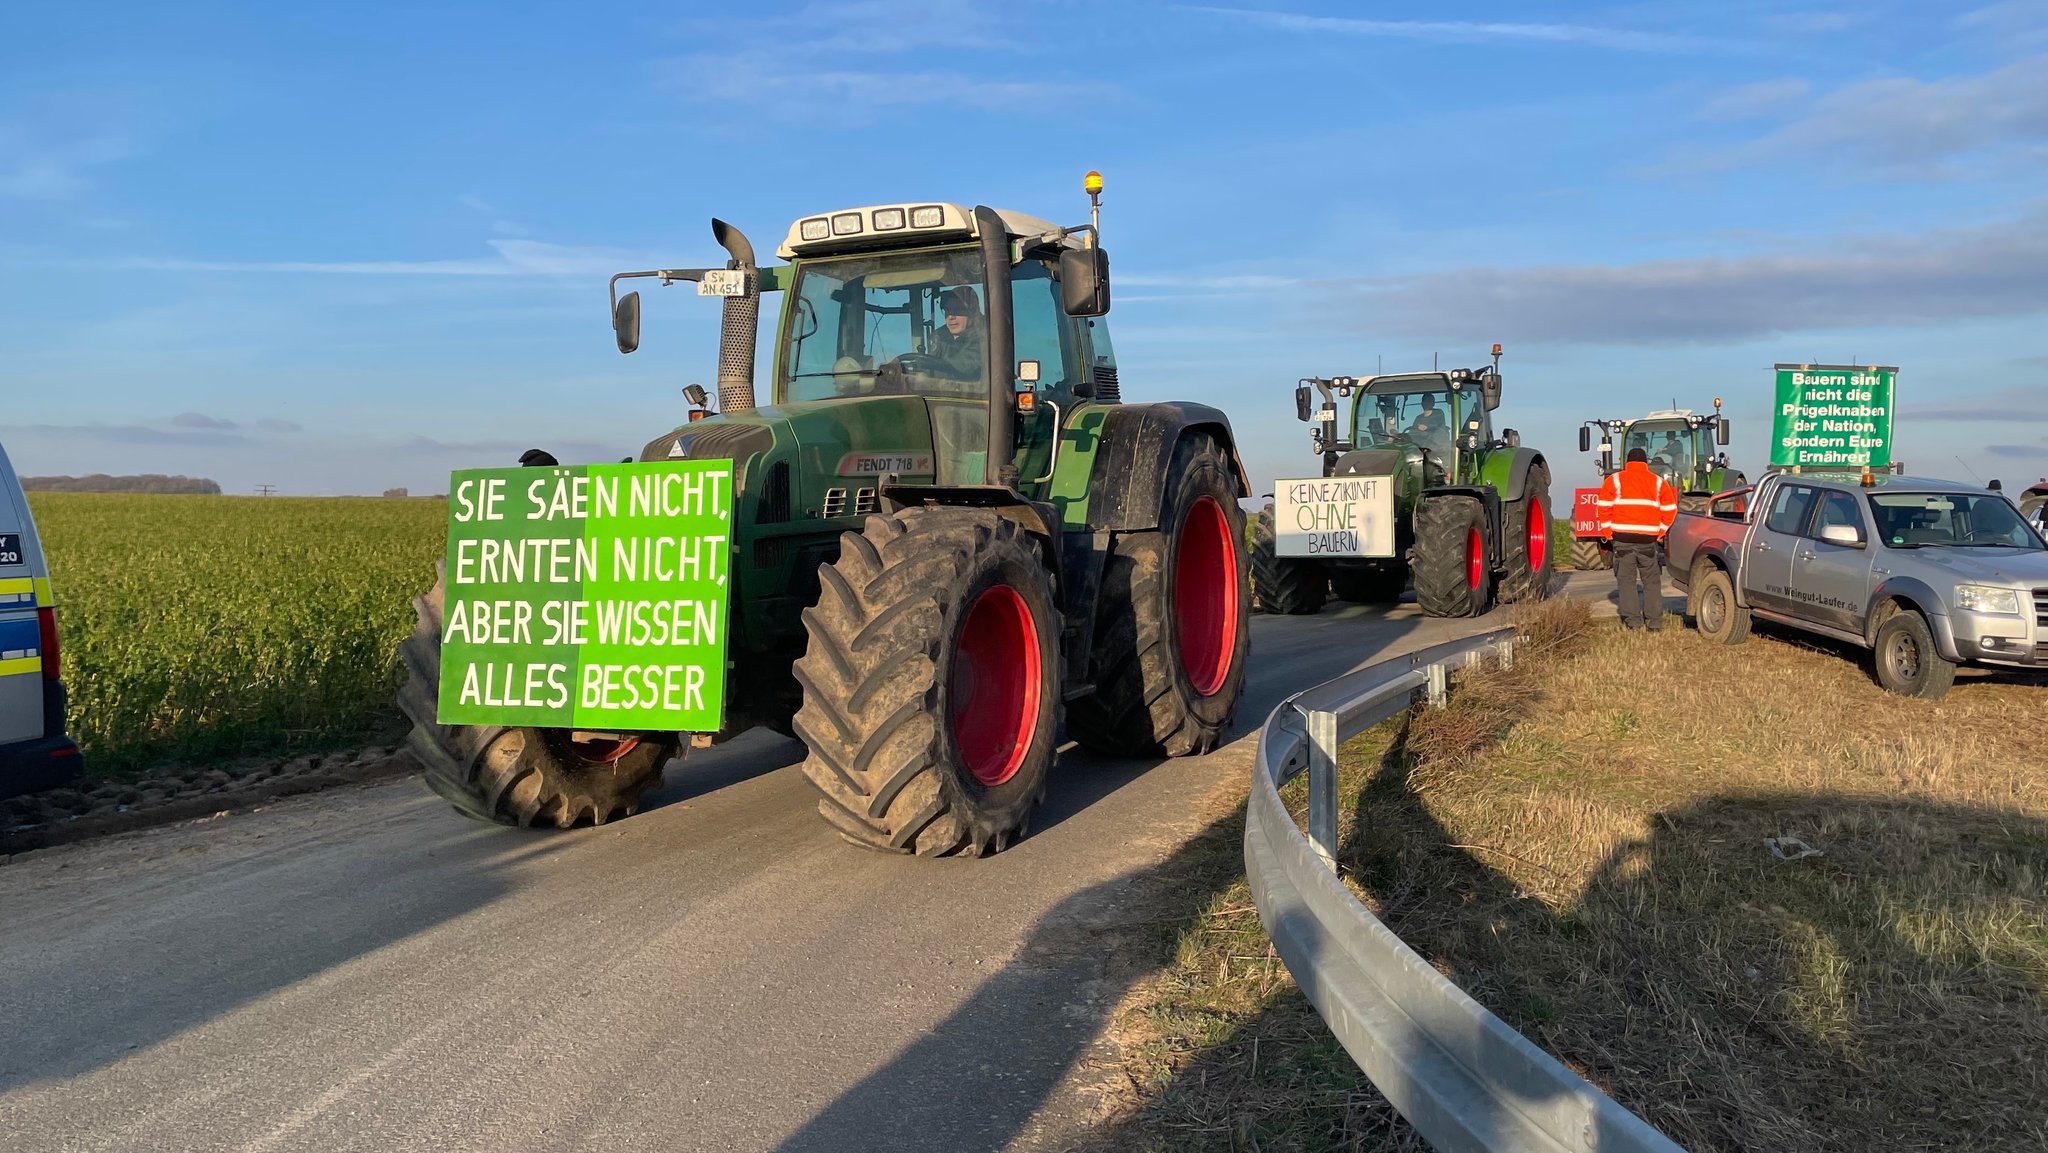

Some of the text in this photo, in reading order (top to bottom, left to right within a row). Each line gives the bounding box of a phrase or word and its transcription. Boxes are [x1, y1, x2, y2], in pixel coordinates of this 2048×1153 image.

[711, 272, 725, 283] SW
[702, 283, 739, 294] AN 451
[1792, 373, 1880, 385] Bauern sind
[1805, 389, 1872, 400] nicht die
[1782, 404, 1885, 418] Prügelknaben
[1794, 419, 1877, 434] der Nation,
[1782, 435, 1883, 447] sondern Eure
[1799, 450, 1871, 462] Ernährer!
[857, 458, 892, 471] FENDT
[896, 457, 912, 470] 718
[454, 469, 728, 522] SIE SÄEN NICHT,
[1290, 480, 1378, 504] KEINE ZUKUNFT
[1580, 494, 1599, 505] STO
[1297, 502, 1357, 531] OHNE
[1576, 521, 1595, 532] UND
[1308, 530, 1358, 553] BAUERN
[455, 535, 725, 586] ERNTEN NICHT,
[1765, 583, 1858, 613] www.Weingut-Laufer.de
[443, 600, 717, 646] ABER SIE WISSEN
[459, 662, 705, 711] ALLES BESSER
